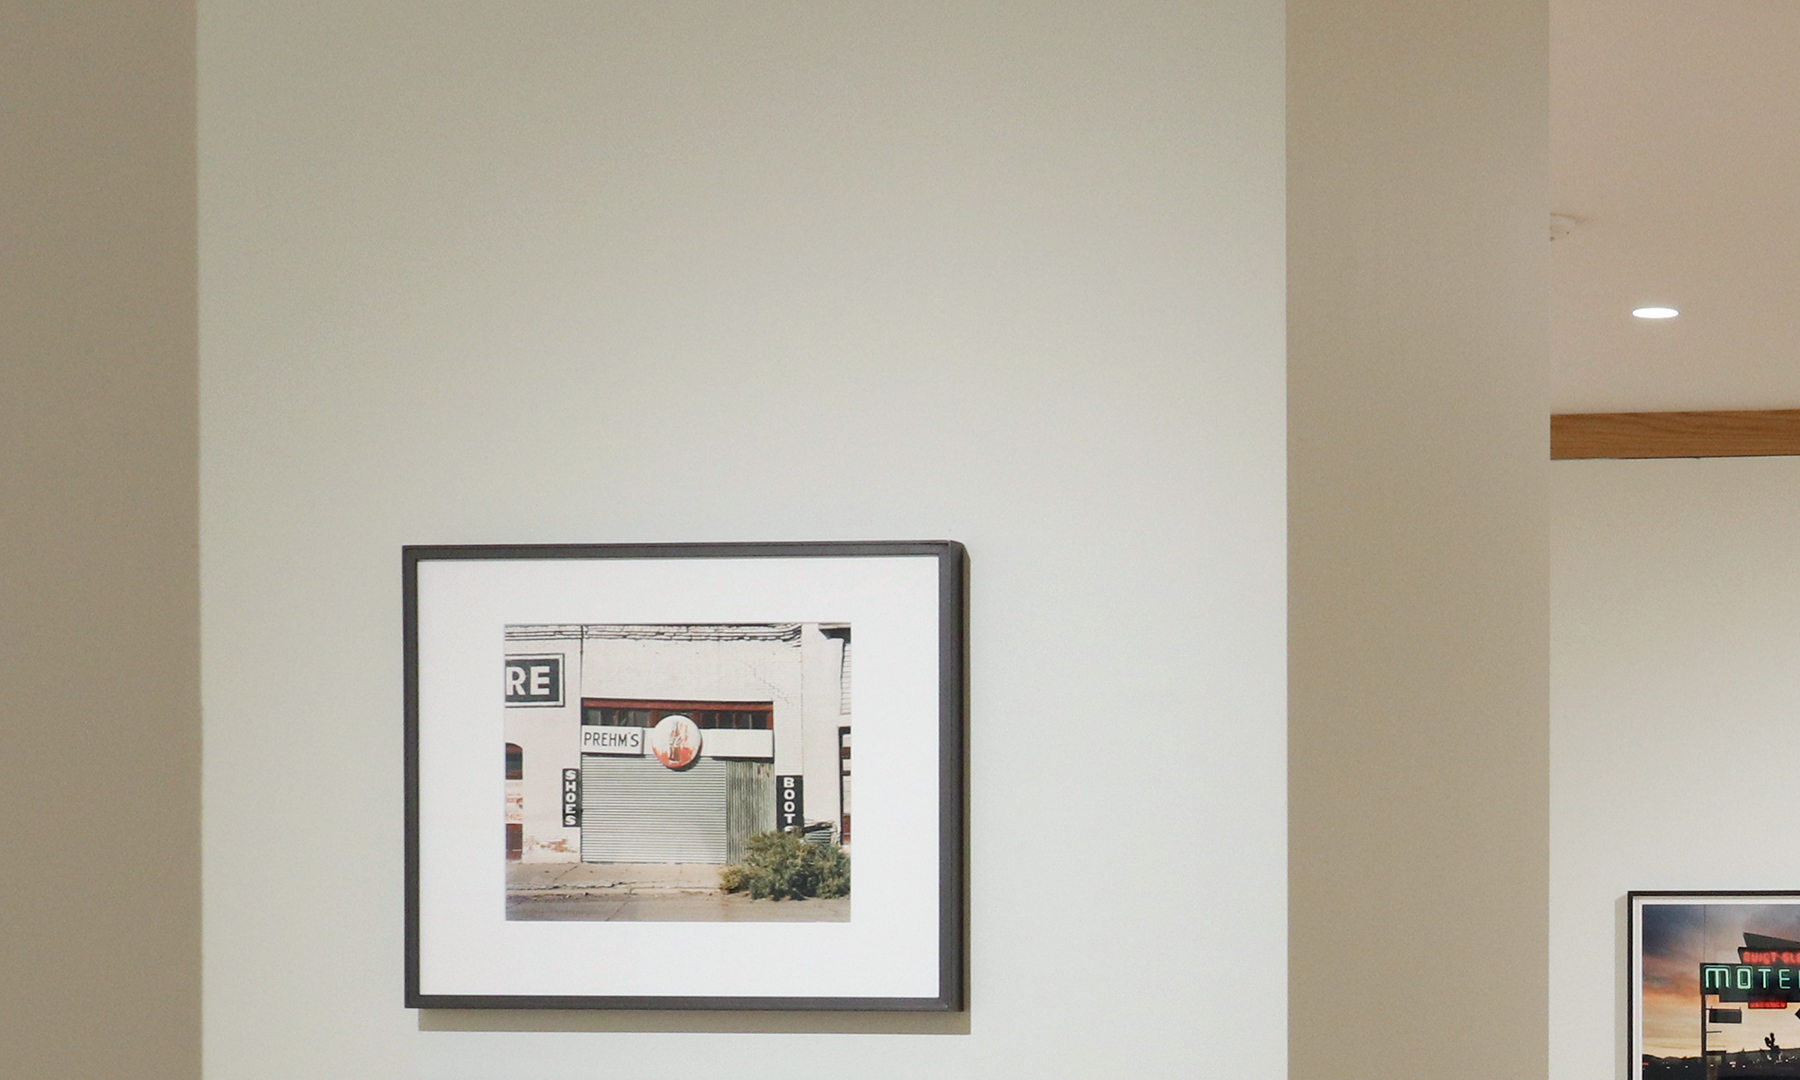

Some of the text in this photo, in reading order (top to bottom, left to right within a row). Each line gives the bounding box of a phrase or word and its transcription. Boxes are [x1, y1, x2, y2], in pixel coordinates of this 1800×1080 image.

[505, 665, 551, 697] RE
[583, 731, 640, 748] PREHM'S
[565, 769, 577, 826] SHOES
